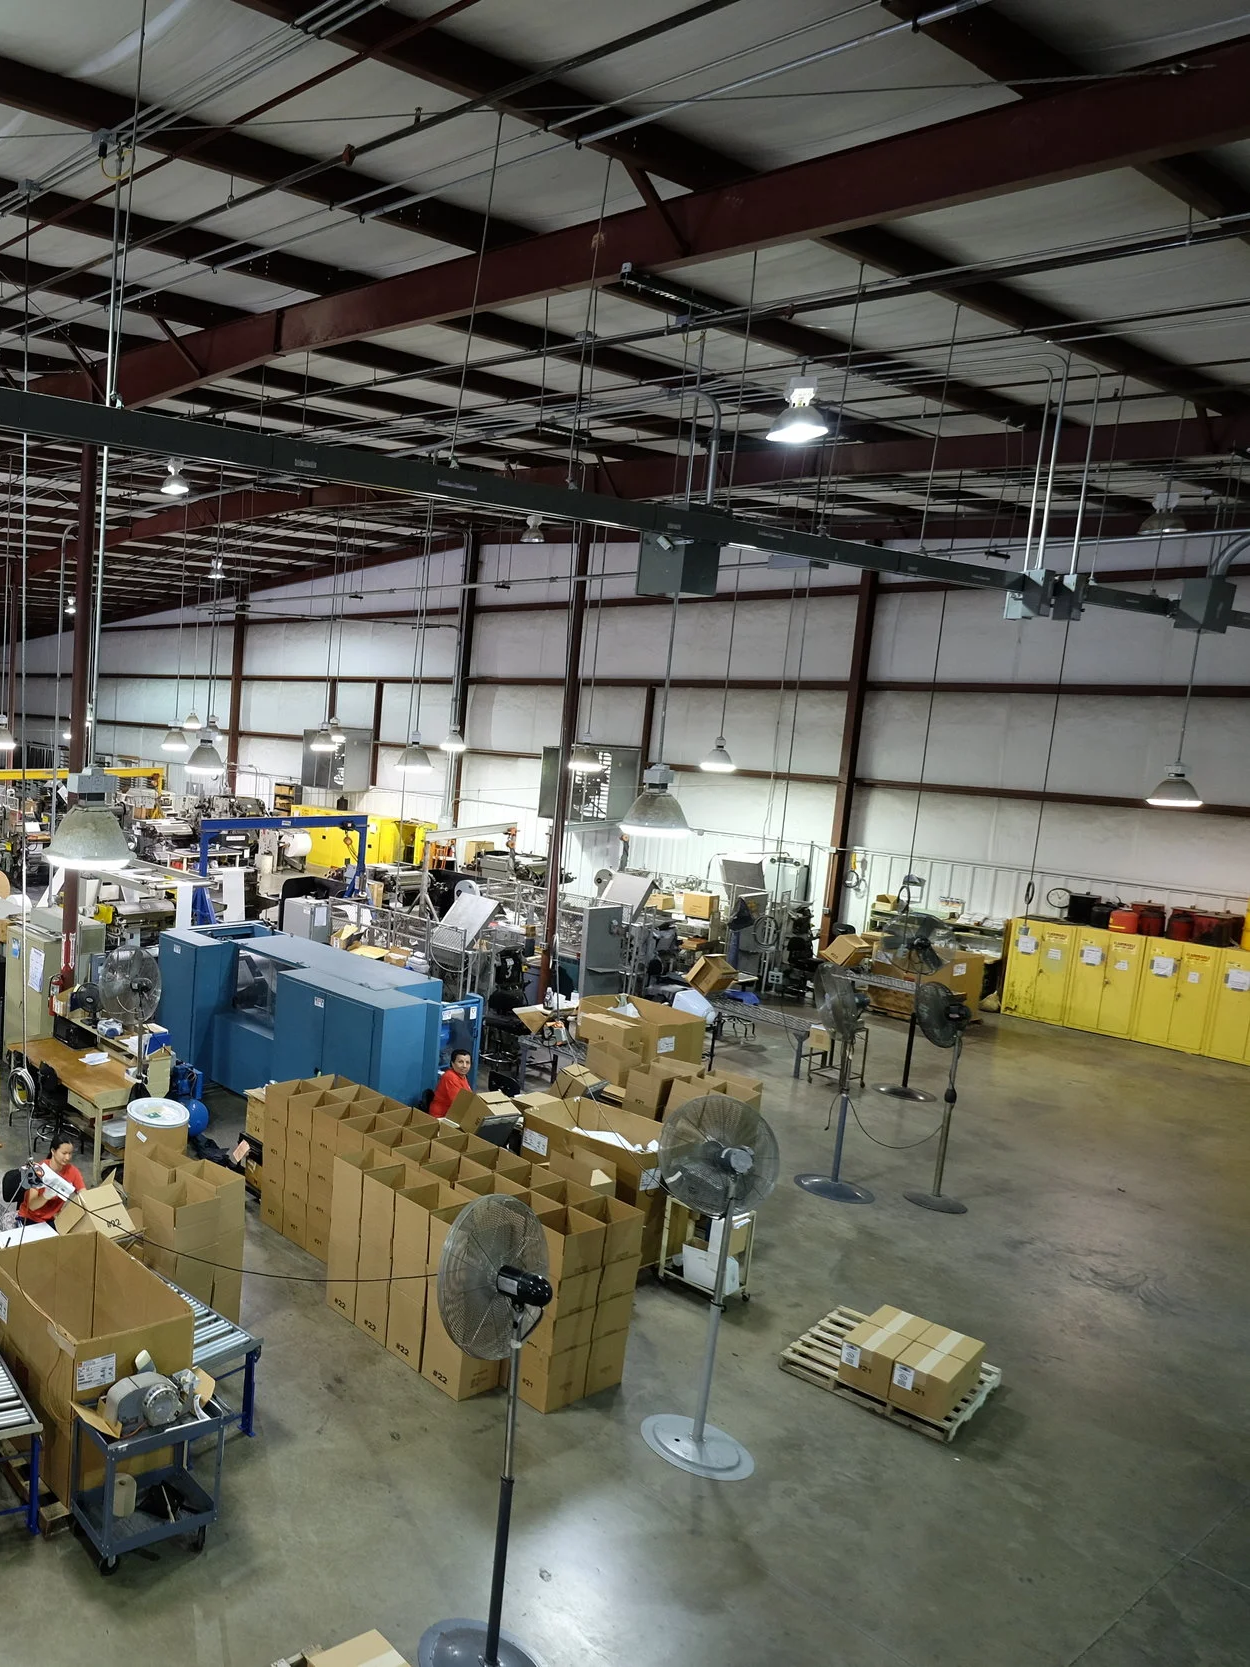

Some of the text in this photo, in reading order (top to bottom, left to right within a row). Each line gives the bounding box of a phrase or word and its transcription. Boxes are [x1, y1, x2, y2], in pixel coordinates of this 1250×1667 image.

[334, 1297, 346, 1311] #22
[364, 1318, 377, 1333] #22
[395, 1342, 410, 1357] #22
[432, 1369, 448, 1385] #22
[522, 1377, 533, 1388] #21
